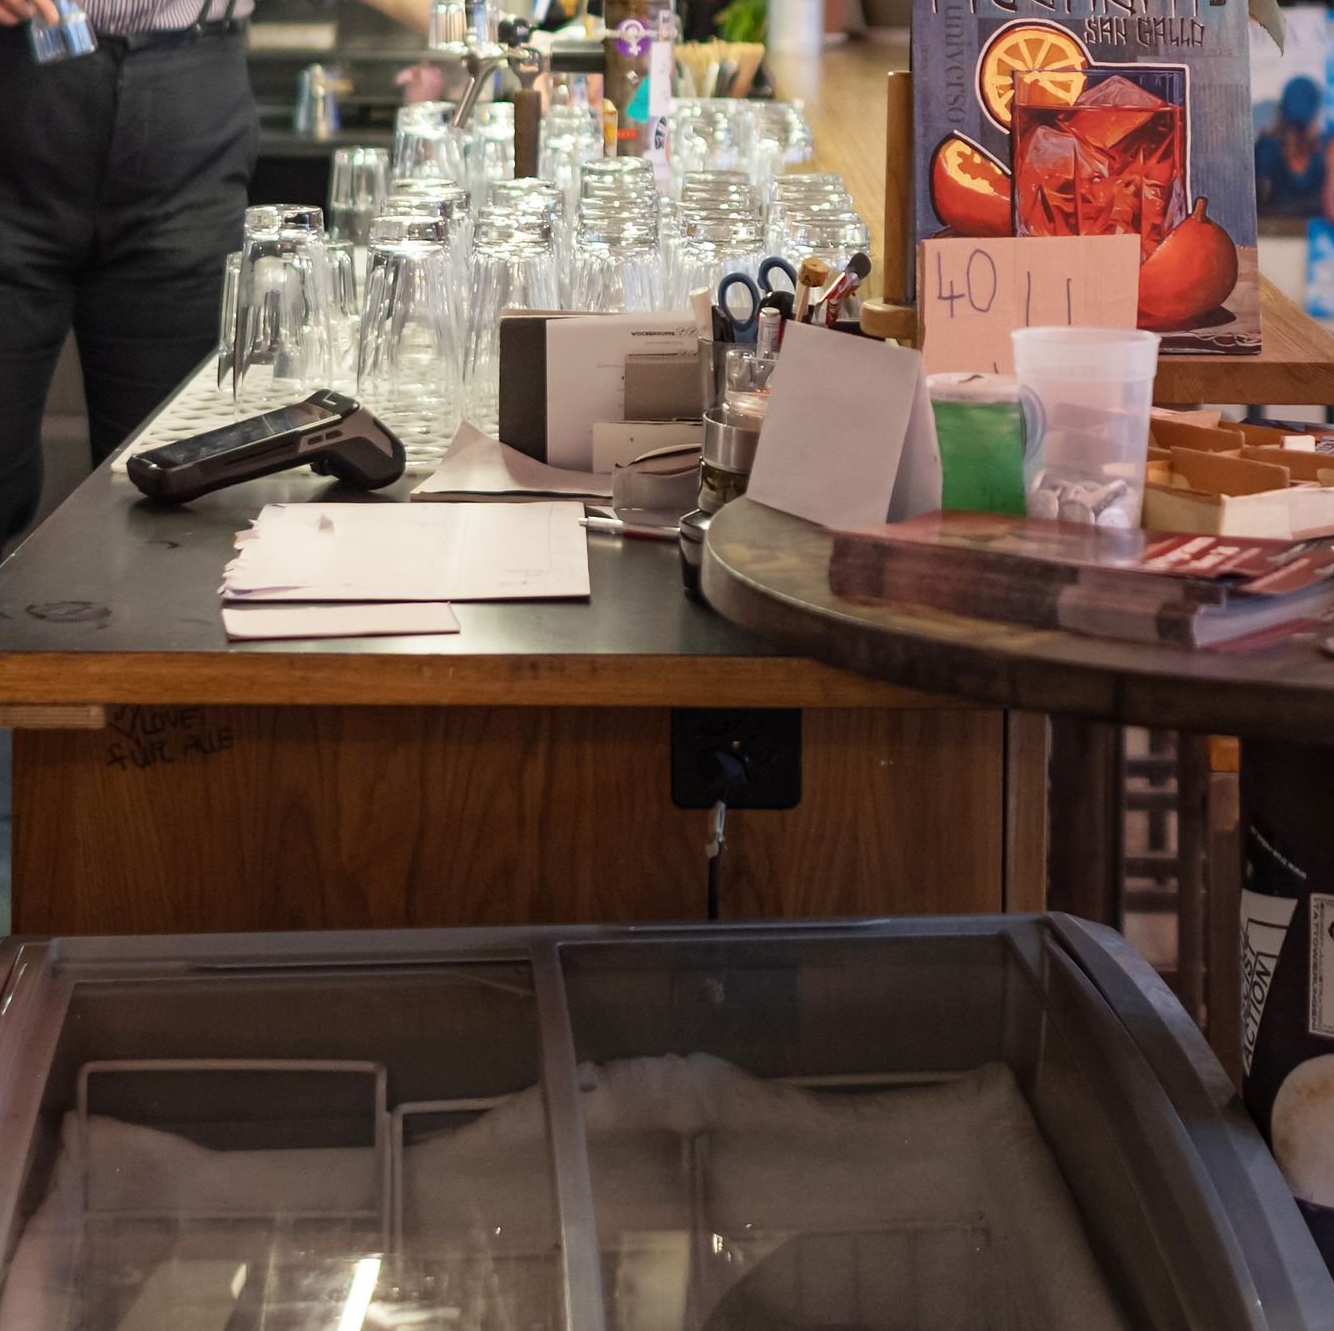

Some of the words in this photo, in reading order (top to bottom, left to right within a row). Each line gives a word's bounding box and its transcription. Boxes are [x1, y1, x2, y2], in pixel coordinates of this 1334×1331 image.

[1084, 16, 1127, 47] SAN
[937, 248, 998, 319] 40
[1245, 958, 1272, 1068] ACTION
